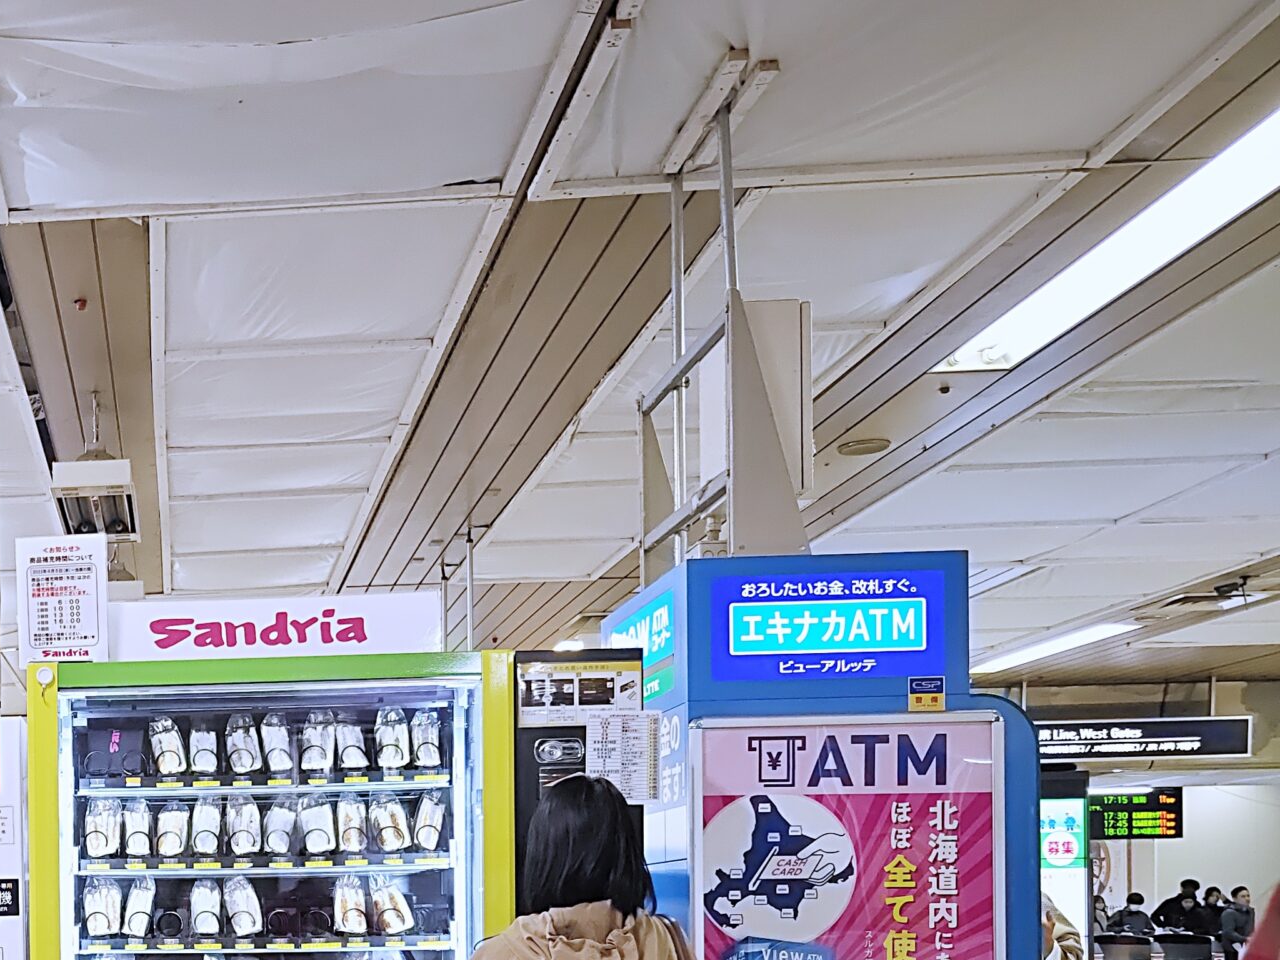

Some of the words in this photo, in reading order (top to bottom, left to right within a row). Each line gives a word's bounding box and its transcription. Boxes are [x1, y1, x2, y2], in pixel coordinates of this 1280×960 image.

[29, 554, 93, 564] 商品補充時間について
[741, 578, 919, 598] おろしたいお金、改札すぐ。
[149, 608, 368, 650] Sandria
[739, 607, 916, 645] エキナカATM
[42, 648, 89, 657] Sandria
[778, 658, 877, 675] ビューアルッテ
[912, 680, 941, 689] CSP
[807, 733, 948, 787] ATM
[1103, 795, 1129, 805] 17:15
[1103, 811, 1129, 819] 17:30
[1103, 819, 1129, 827] 17:45
[1103, 827, 1129, 835] 18:00
[775, 858, 808, 867] CASH
[771, 867, 804, 876] CARD
